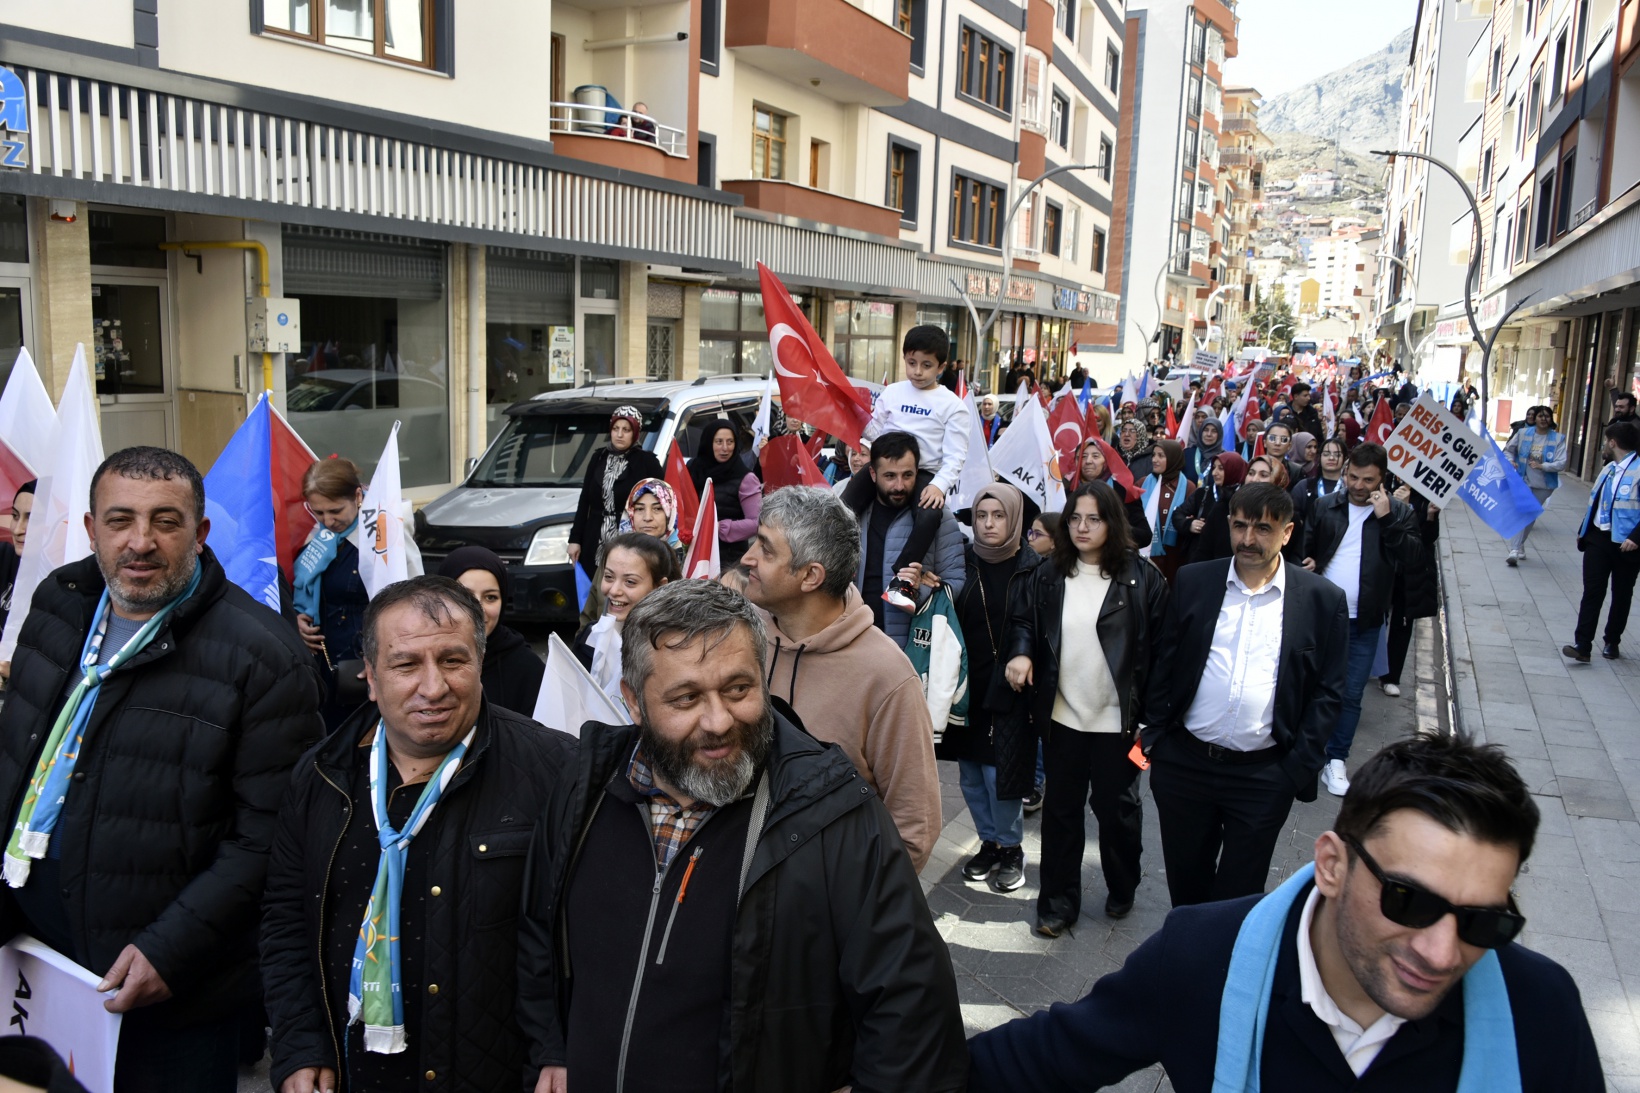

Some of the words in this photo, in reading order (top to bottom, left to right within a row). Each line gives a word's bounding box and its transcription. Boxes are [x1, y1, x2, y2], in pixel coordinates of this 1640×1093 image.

[901, 404, 932, 416] miav
[1453, 438, 1478, 466] Güç
[1012, 466, 1035, 485] AK
[1388, 444, 1416, 469] OY
[1412, 461, 1452, 498] VER!
[10, 968, 32, 1036] AK
